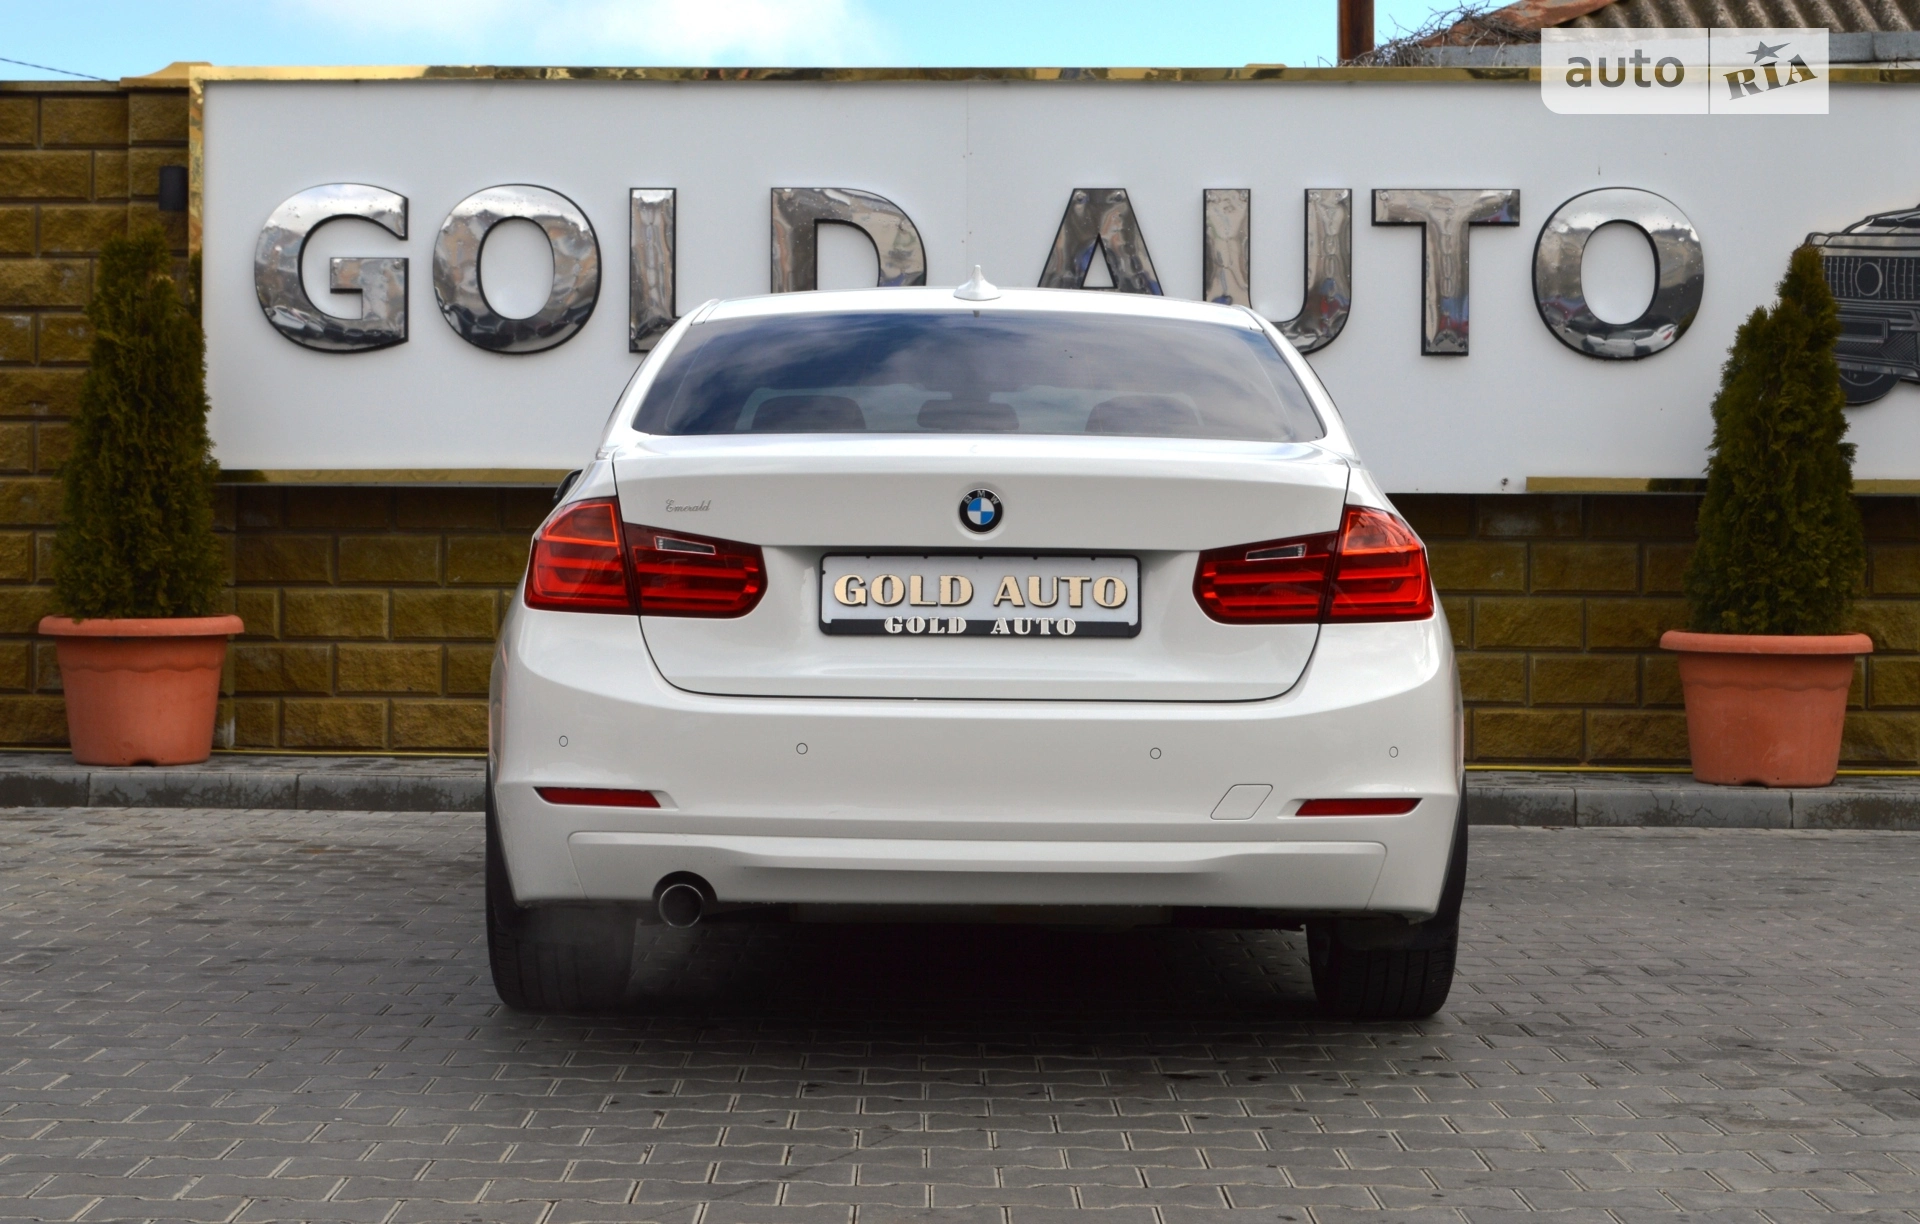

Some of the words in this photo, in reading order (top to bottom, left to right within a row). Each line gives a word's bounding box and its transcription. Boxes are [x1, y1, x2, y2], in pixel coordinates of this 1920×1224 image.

[254, 182, 928, 355] GOLD
[1037, 186, 1705, 360] AUTO
[665, 498, 712, 513] Emerald
[963, 489, 1000, 505] BMW
[833, 574, 974, 607] GOLD
[993, 576, 1129, 608] AUTO
[884, 615, 967, 635] GOLD
[990, 616, 1077, 636] AUTO
